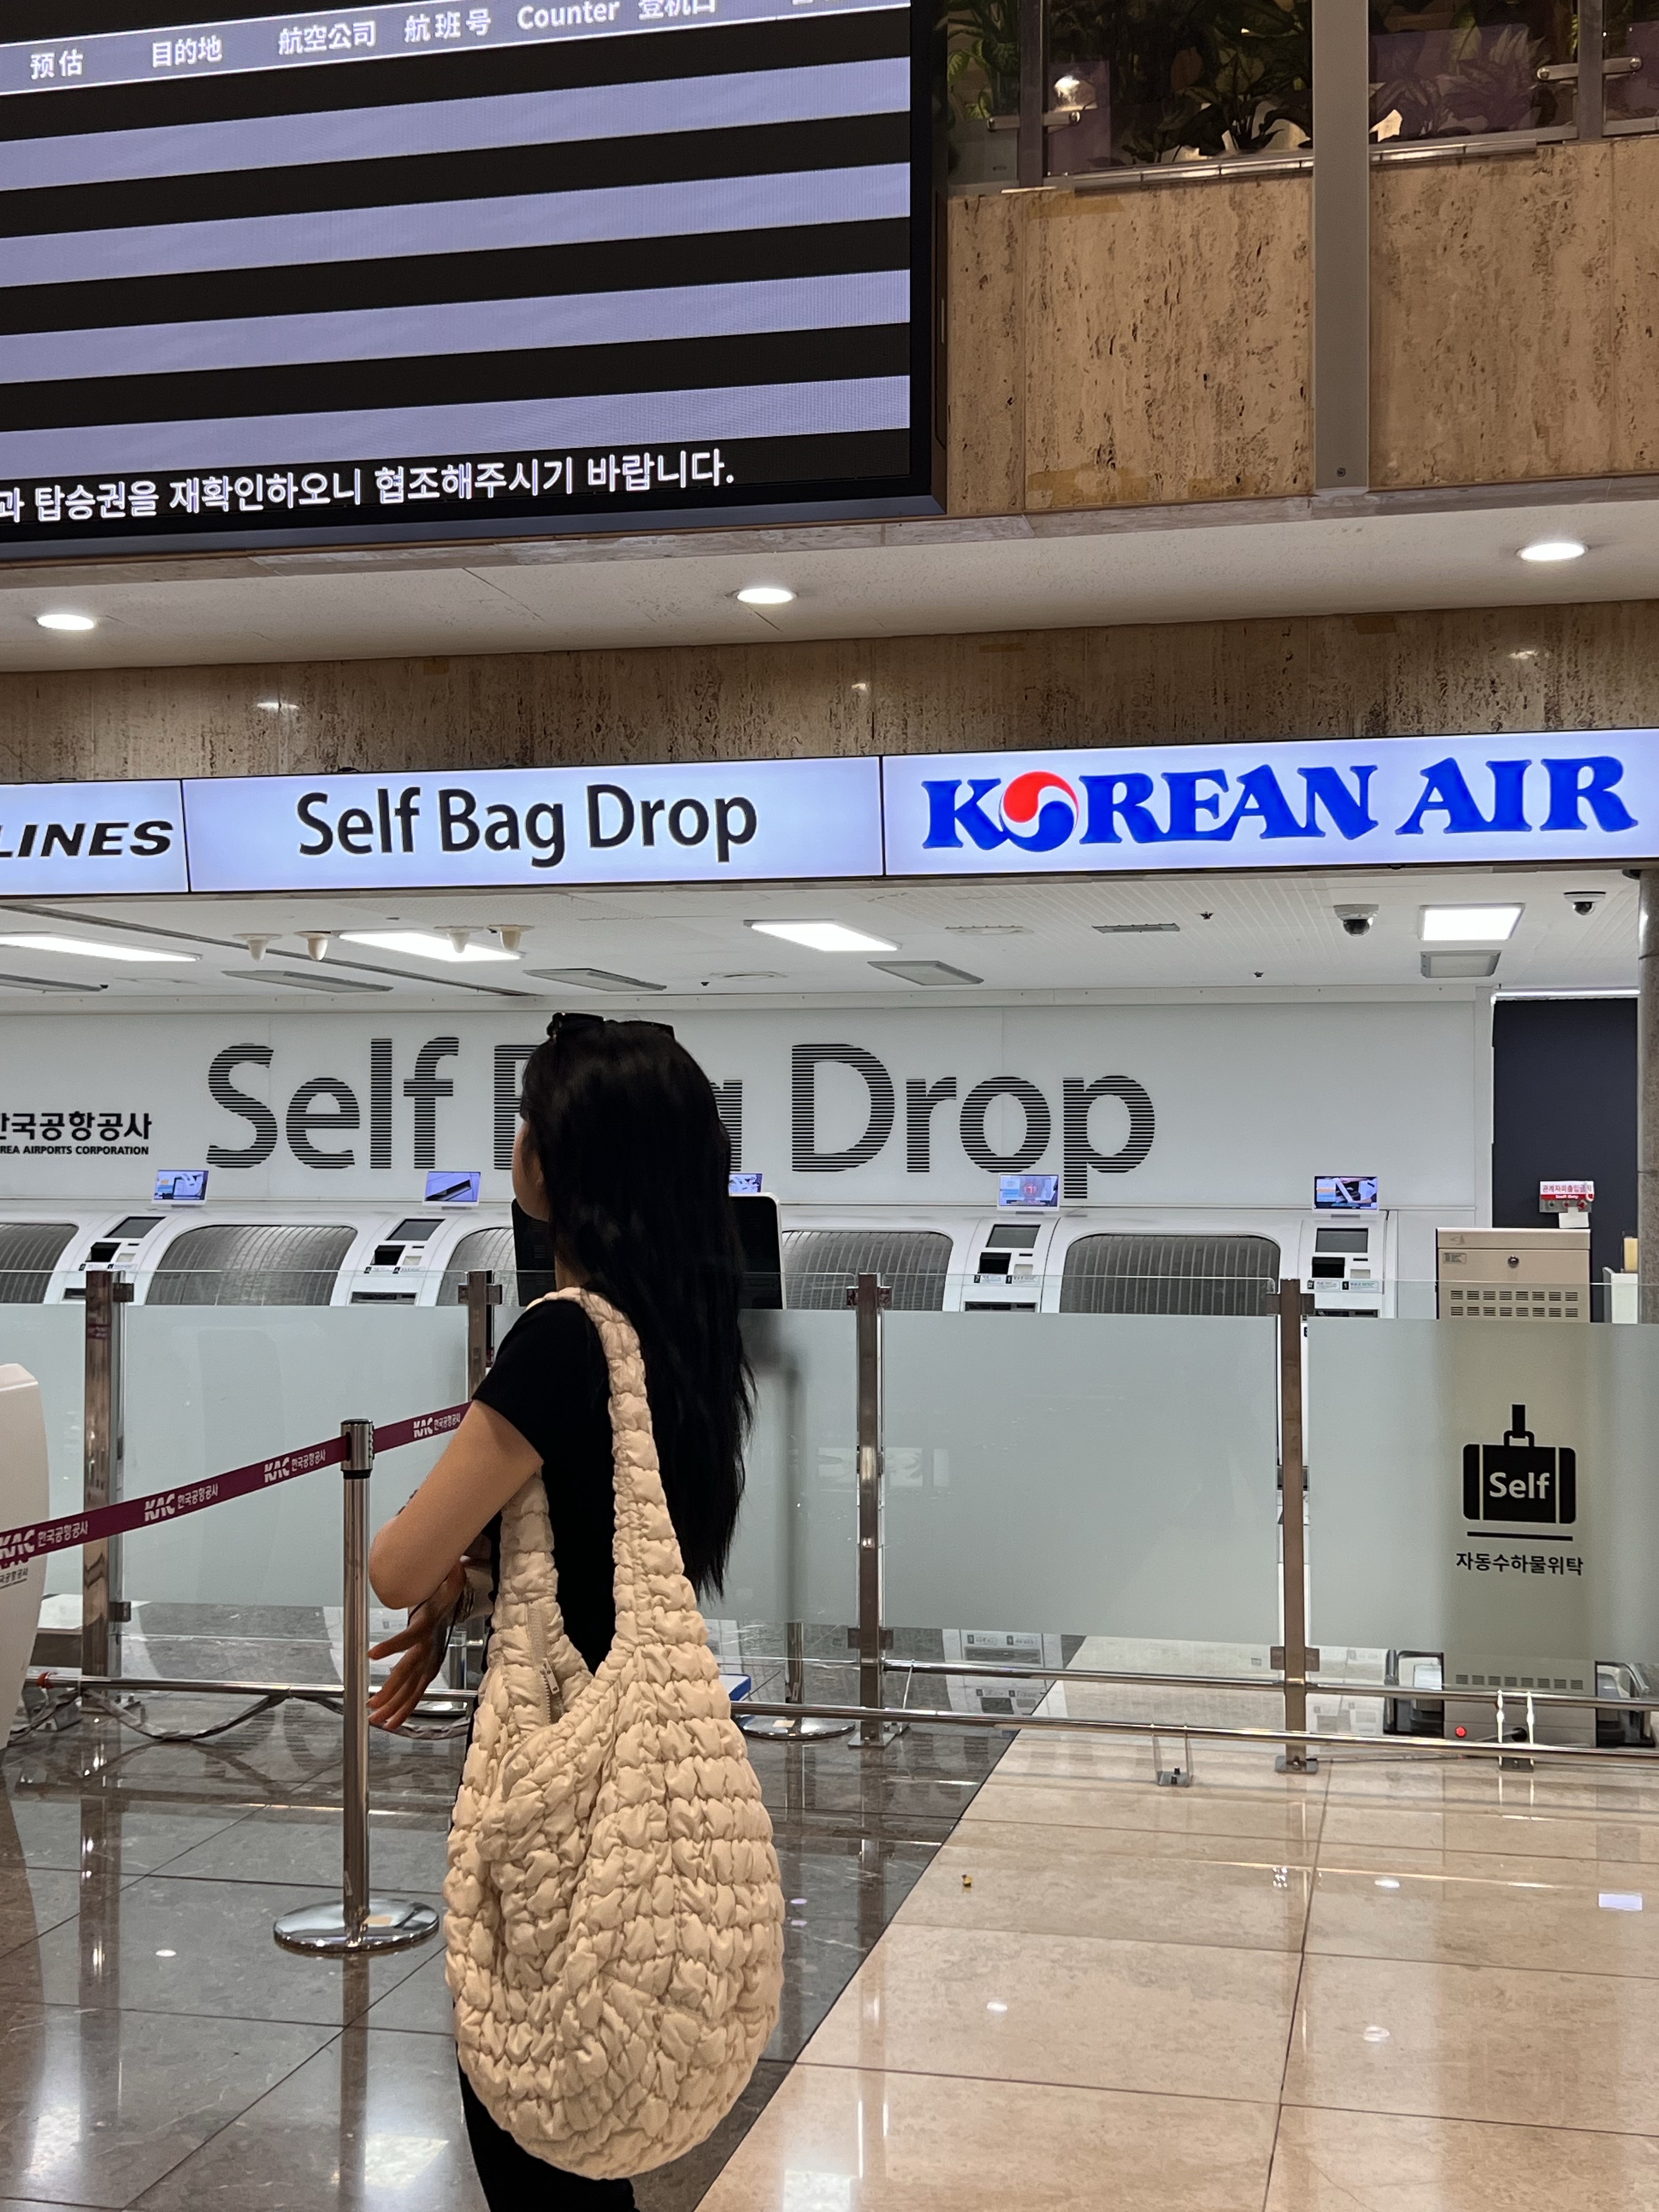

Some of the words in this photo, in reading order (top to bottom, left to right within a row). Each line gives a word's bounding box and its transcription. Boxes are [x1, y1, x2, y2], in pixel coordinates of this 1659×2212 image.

[30, 49, 83, 80] 预估
[152, 35, 223, 67] 目的地
[278, 20, 376, 54] 航空公司
[404, 8, 492, 43] 航班号
[517, 1, 620, 30] Counter
[0, 487, 25, 523] 과
[35, 481, 159, 522] 탑승권을
[169, 467, 360, 514] 재확인하오니
[375, 456, 572, 504] 협조해주시기
[588, 448, 735, 492] 바랍니다.
[921, 765, 1378, 852] KOREAN
[1395, 756, 1639, 836] AIR
[297, 786, 421, 856] Self
[438, 788, 566, 868] Bag
[586, 784, 757, 863] Drop
[206, 1036, 460, 1169] Self
[792, 1043, 1155, 1199] Drop
[22, 1146, 72, 1155] AIRPORTS
[75, 1146, 149, 1155] CORPORATION
[264, 1457, 290, 1483] KAC
[1489, 1472, 1550, 1499] Self
[144, 1493, 176, 1522] KAC
[177, 1483, 219, 1509] 한국공항공사
[38, 1520, 89, 1548] 한국공항공사
[1456, 1551, 1584, 1576] 자동수하물위탁
